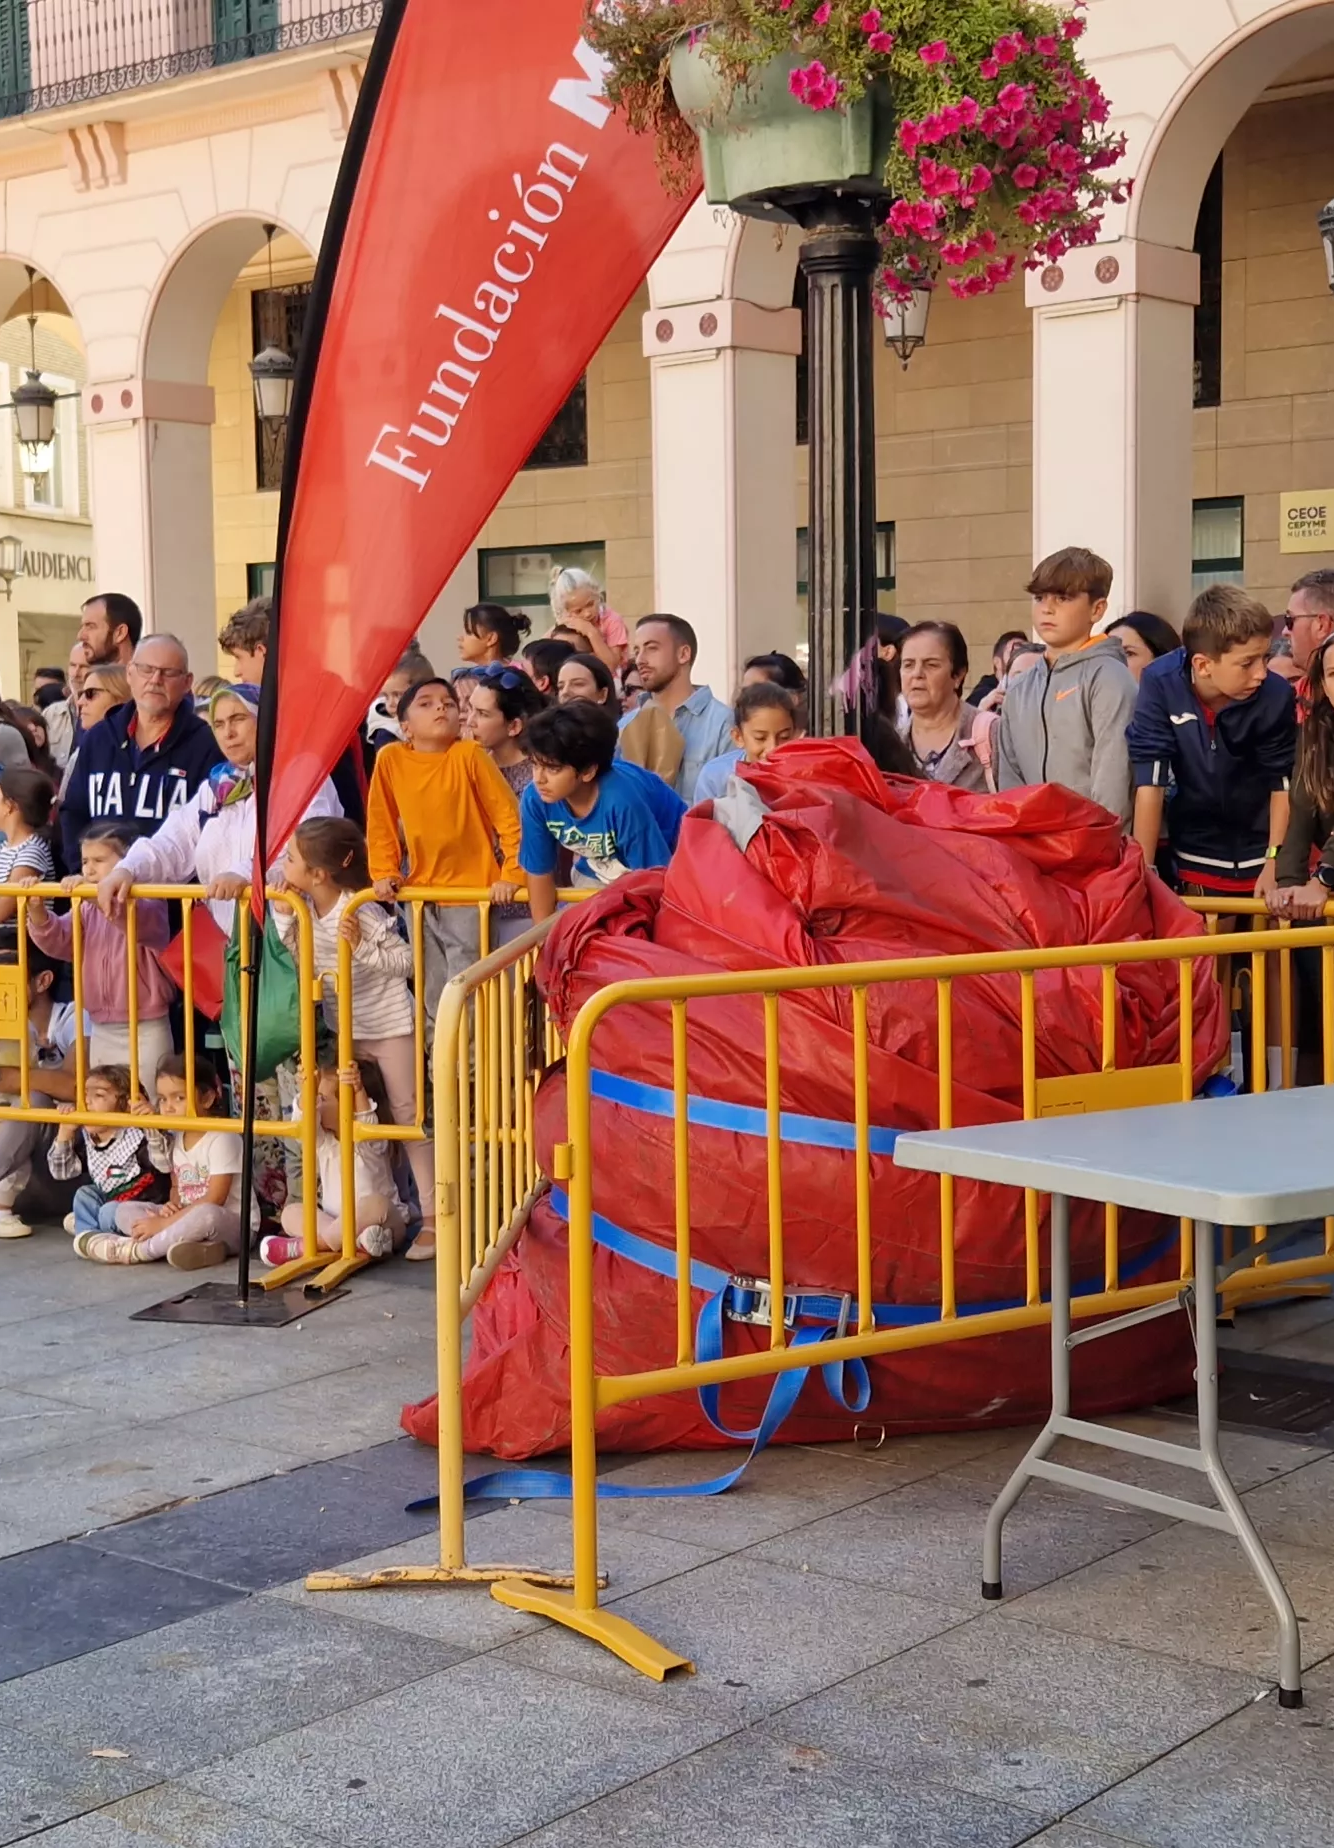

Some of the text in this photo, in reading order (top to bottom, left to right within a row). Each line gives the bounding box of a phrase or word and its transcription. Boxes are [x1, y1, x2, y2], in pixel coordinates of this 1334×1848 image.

[365, 140, 589, 494] Fundación
[1287, 506, 1327, 520] CEOE
[1287, 519, 1327, 530] CEPYME
[1287, 529, 1327, 538] HUESCA
[22, 550, 95, 583] AUDIENCI
